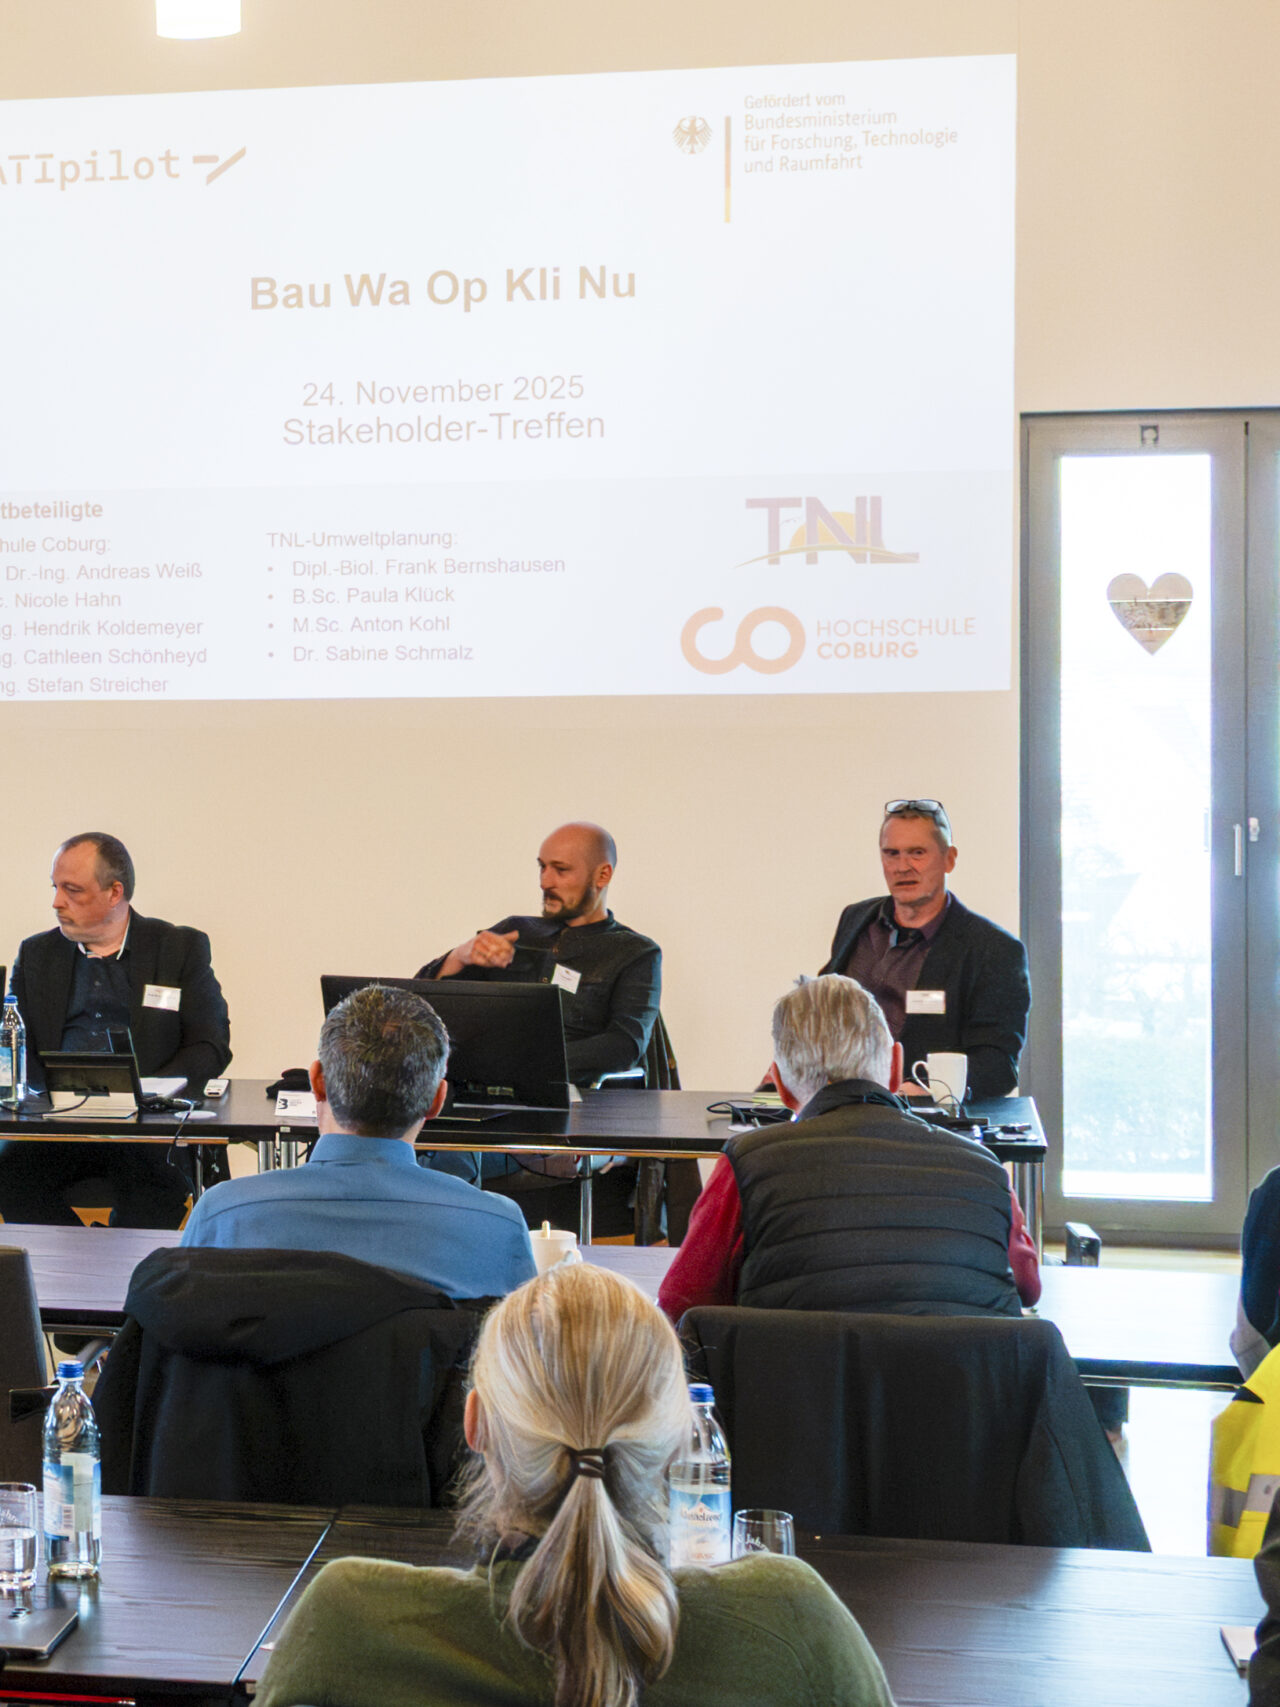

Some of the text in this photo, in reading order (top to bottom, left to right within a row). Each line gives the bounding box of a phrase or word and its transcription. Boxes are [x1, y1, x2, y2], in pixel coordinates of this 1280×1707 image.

[743, 92, 845, 109] Gefördert vom
[743, 109, 897, 130] Bundesministerium
[743, 127, 959, 152] für Forschung, Technologie
[743, 153, 863, 174] und Raumfahrt
[249, 264, 638, 313] Bau Wa Op Kli Nu
[302, 374, 586, 408] 24. November 2025
[281, 411, 606, 446] Stakeholder-Treffen
[266, 530, 458, 550] TNL-Umweltplanung:
[744, 495, 920, 566] TNL
[41, 536, 112, 556] Coburg:
[5, 564, 71, 584] Dr.-Ing.
[76, 564, 151, 580] Andreas
[156, 562, 203, 579] Weiß
[292, 556, 567, 580] Dipl.-Biol. Frank Bernshausen
[14, 592, 70, 608] Nicole
[75, 591, 122, 608] Hahn
[292, 586, 456, 605] B.Sc. Paula Klück
[23, 620, 91, 637] Hendrik
[97, 619, 204, 639] Koldemeyer
[292, 615, 451, 633] M.Sc. Anton Kohl
[816, 616, 977, 638] HOCHSCHULE
[23, 648, 103, 666] Cathleen
[108, 648, 208, 667] Schönheyd
[292, 645, 474, 662] Dr. Sabine Schmalz
[816, 640, 920, 660] COBURG
[26, 676, 84, 693] Stefan
[89, 676, 169, 693] Streicher
